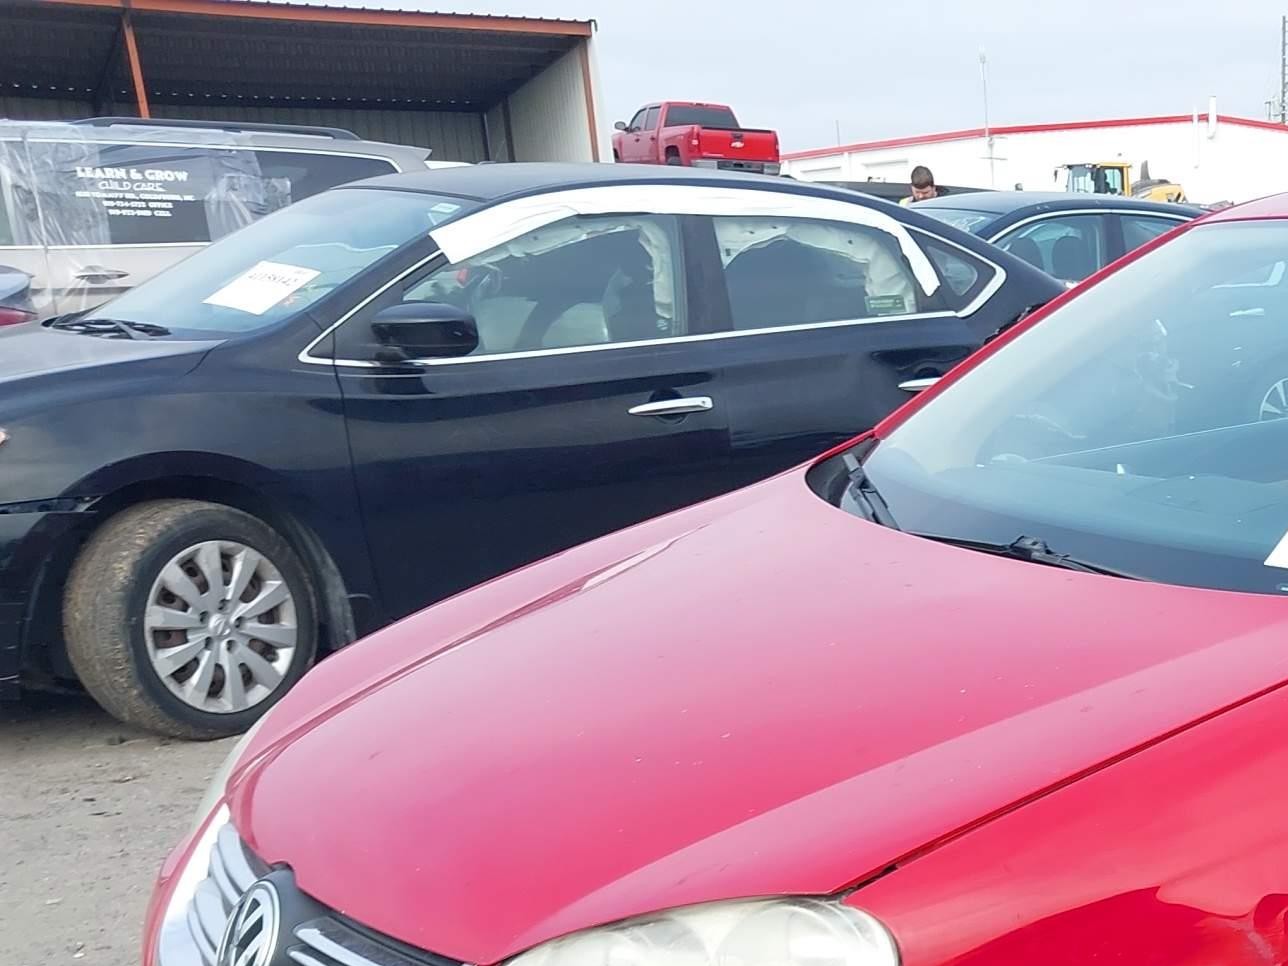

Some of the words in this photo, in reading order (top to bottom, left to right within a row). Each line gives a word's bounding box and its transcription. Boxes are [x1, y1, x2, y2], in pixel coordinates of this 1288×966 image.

[75, 166, 128, 179] LEARN
[129, 169, 143, 180] &
[144, 169, 188, 181] GROW
[132, 182, 167, 192] CARE
